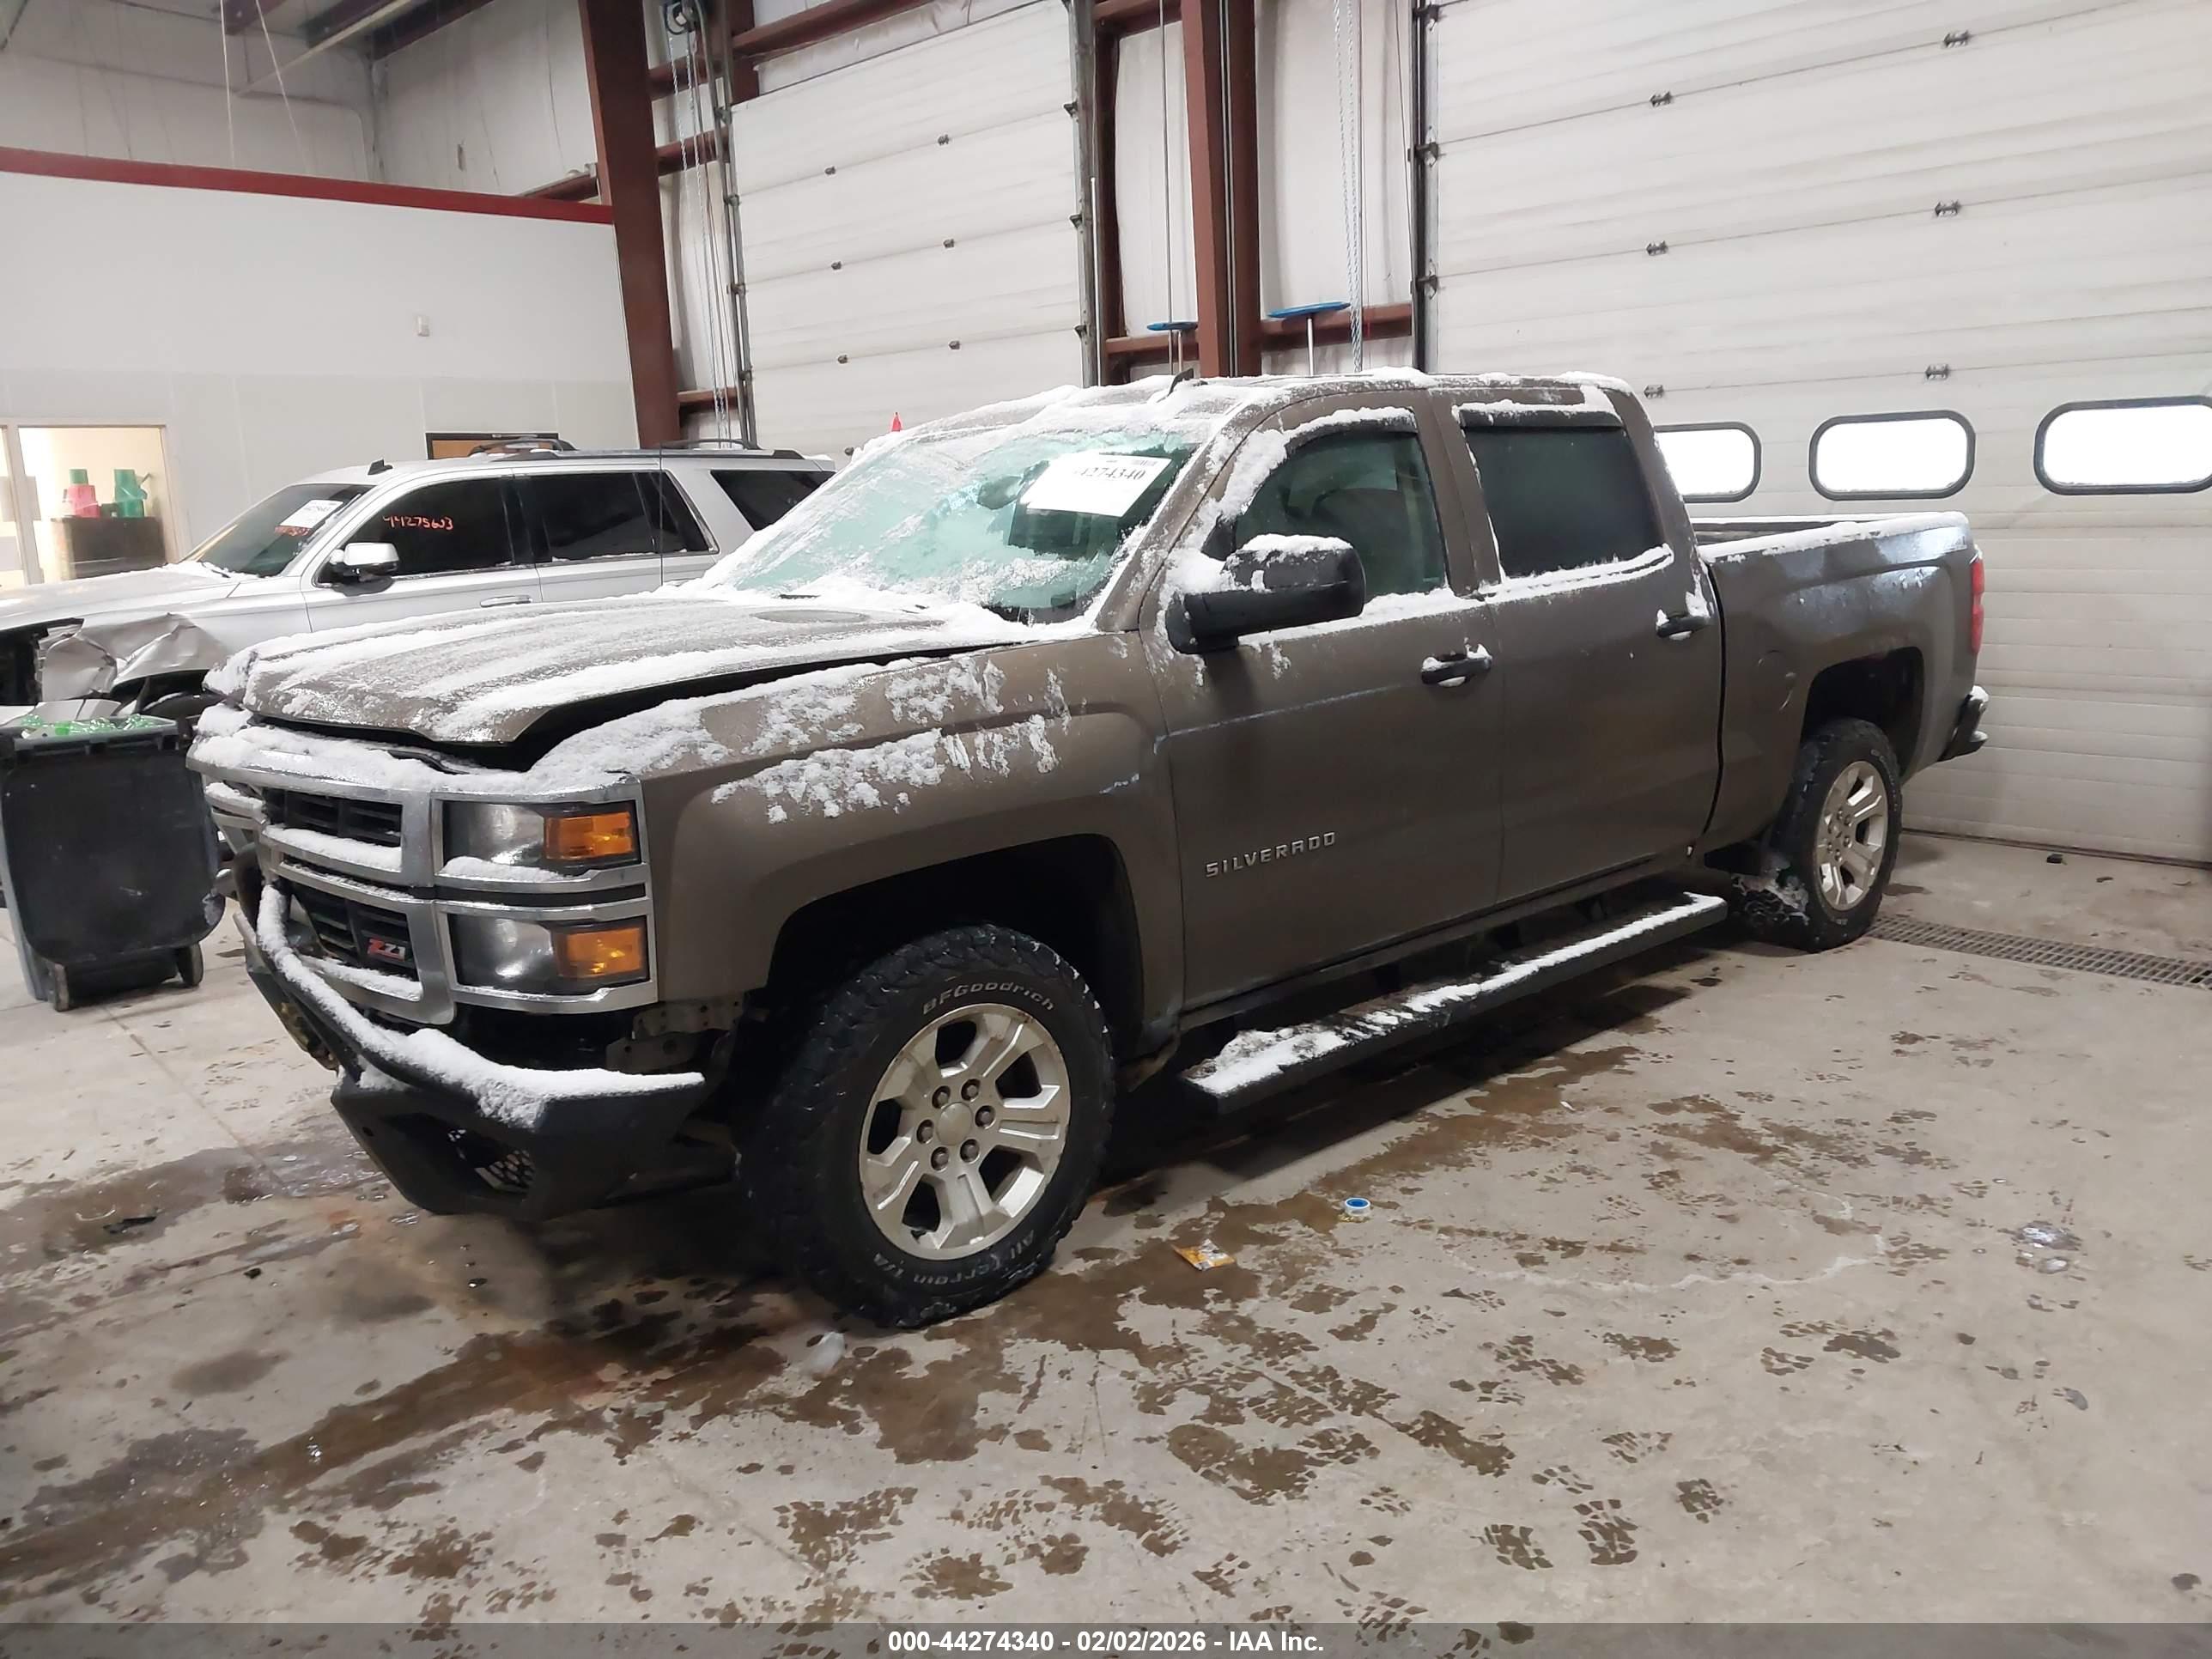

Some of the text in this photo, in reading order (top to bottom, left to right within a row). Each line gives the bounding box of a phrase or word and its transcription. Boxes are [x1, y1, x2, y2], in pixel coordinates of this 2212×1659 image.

[1072, 466, 1146, 481] 4274340
[1206, 832, 1335, 878] SILVERADO
[922, 981, 1054, 1015] BFGoodrich
